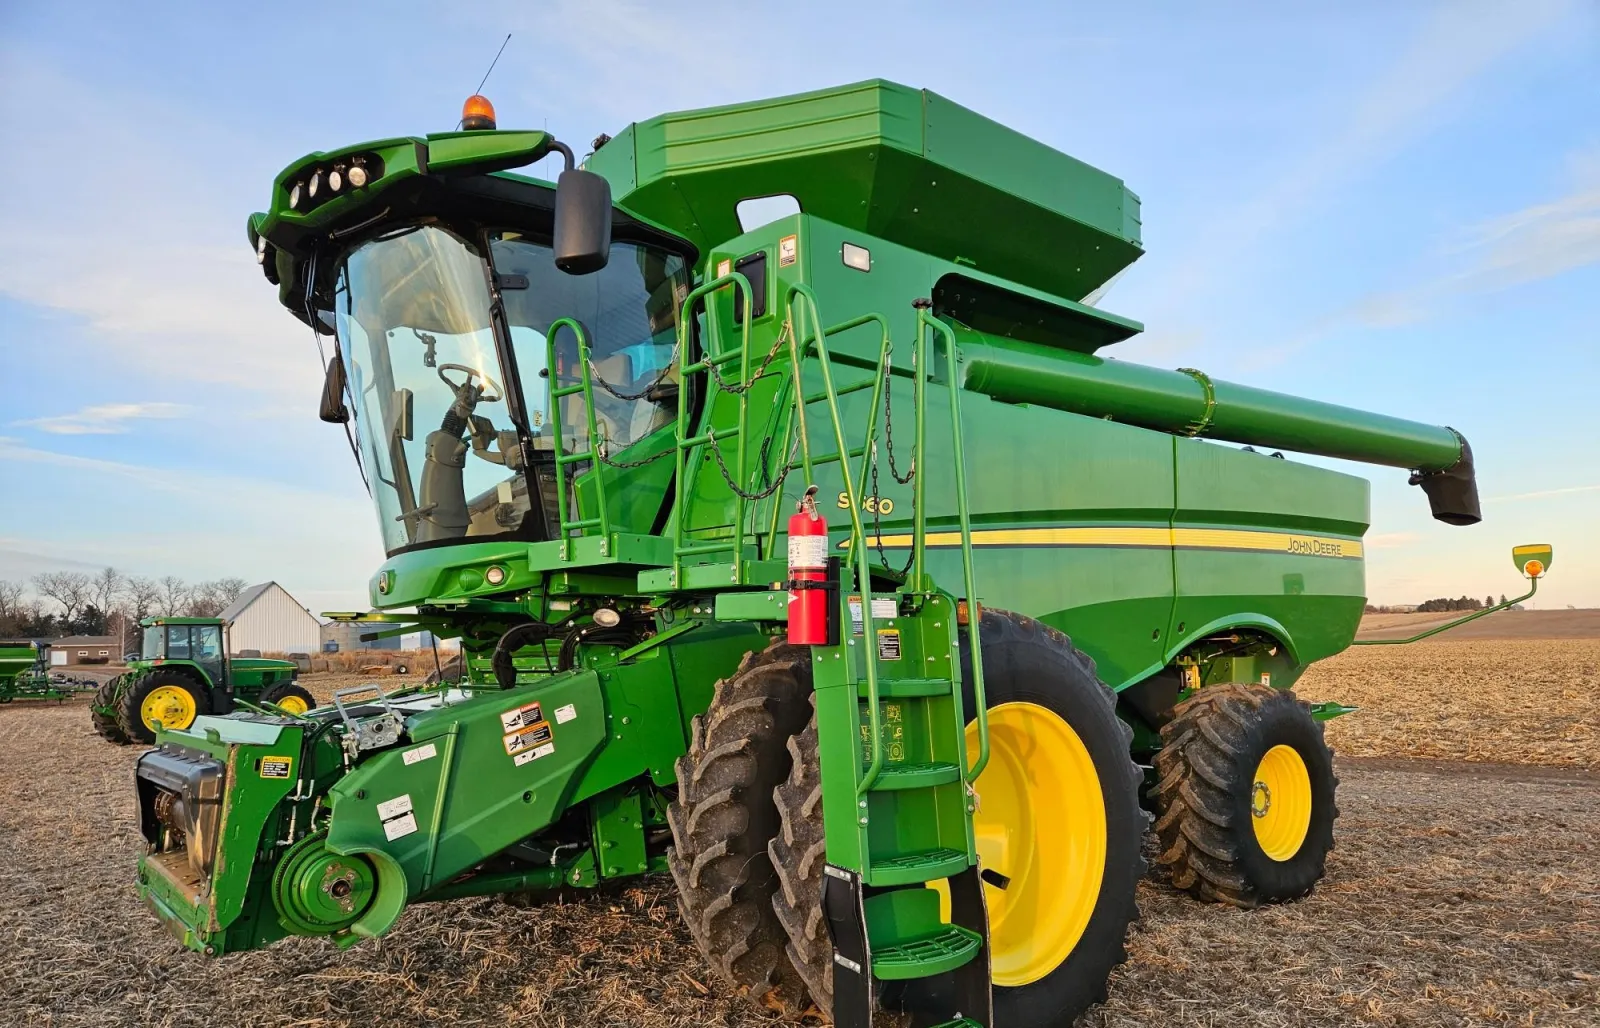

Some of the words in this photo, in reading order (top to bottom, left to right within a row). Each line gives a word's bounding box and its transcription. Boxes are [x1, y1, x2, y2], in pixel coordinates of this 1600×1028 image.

[837, 491, 894, 515] S60
[1287, 537, 1312, 552] JOHN
[1313, 540, 1342, 555] DEERE
